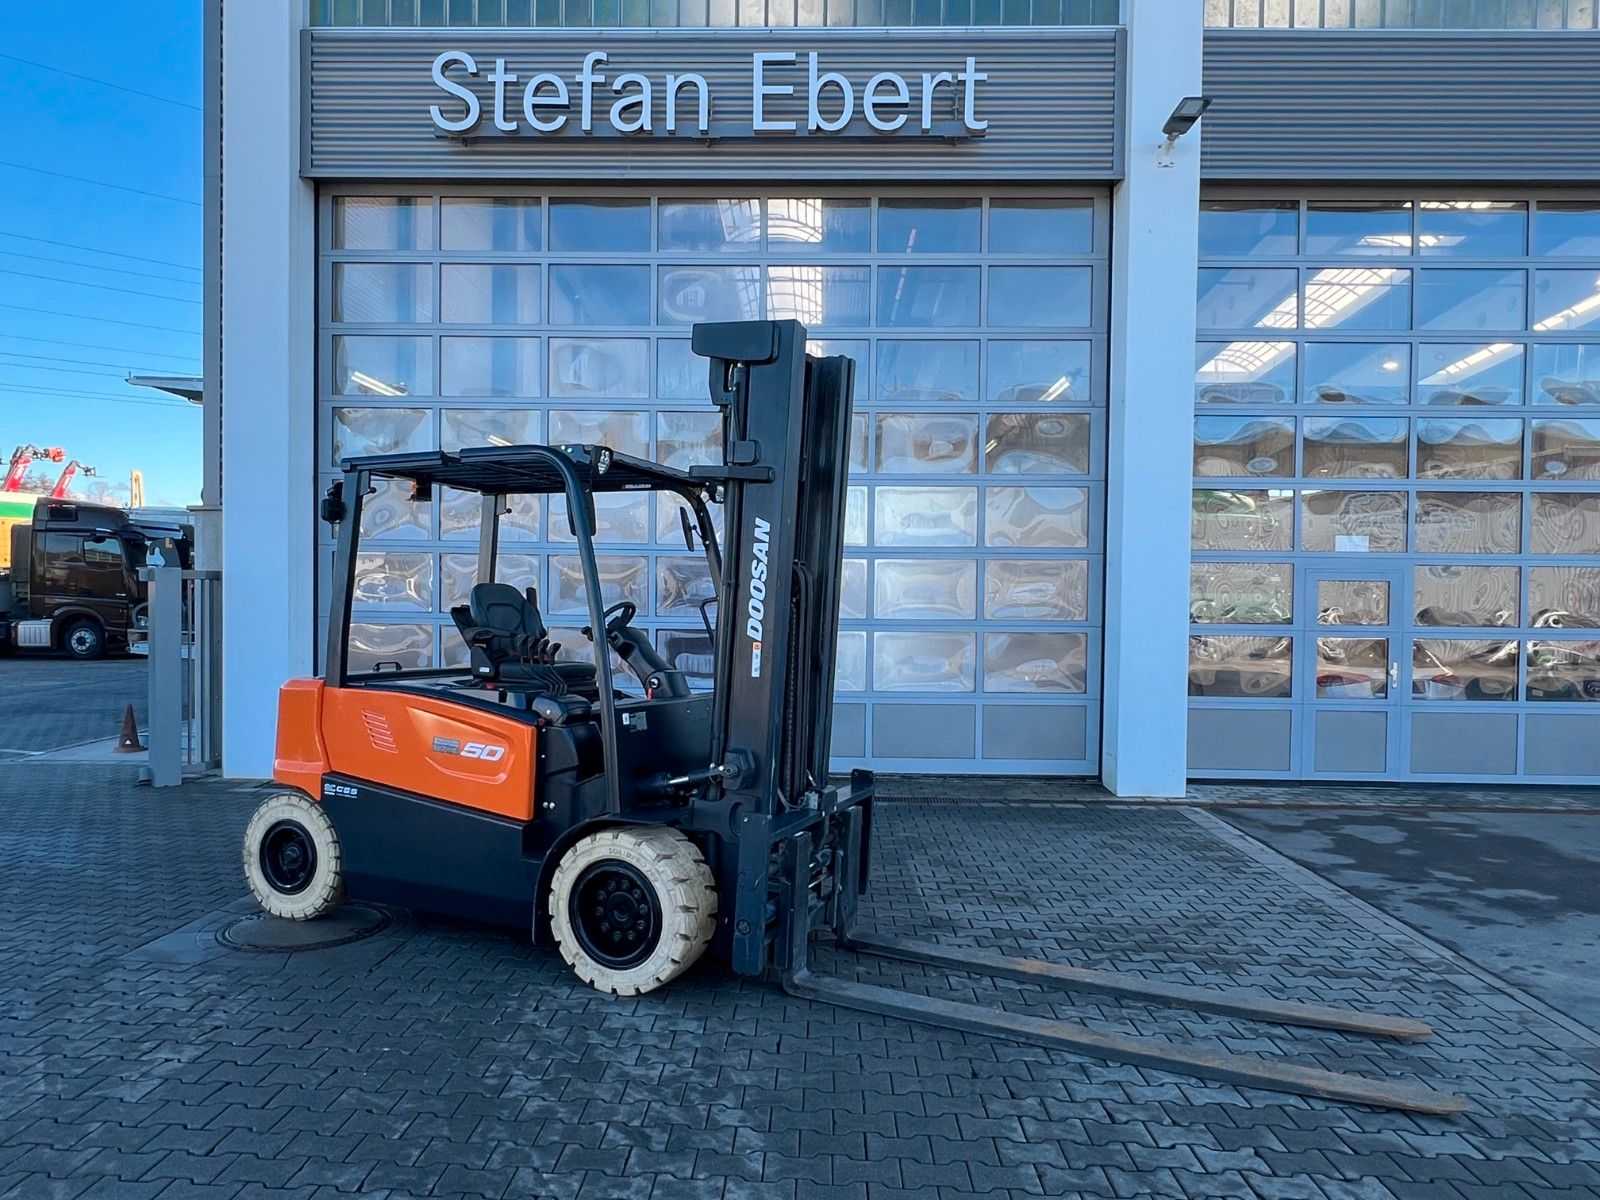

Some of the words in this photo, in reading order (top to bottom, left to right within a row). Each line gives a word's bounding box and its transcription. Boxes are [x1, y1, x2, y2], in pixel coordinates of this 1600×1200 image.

[429, 50, 709, 132] Stefan
[752, 51, 989, 132] Ebert
[747, 517, 771, 642] DOOSAN
[460, 742, 505, 762] 50
